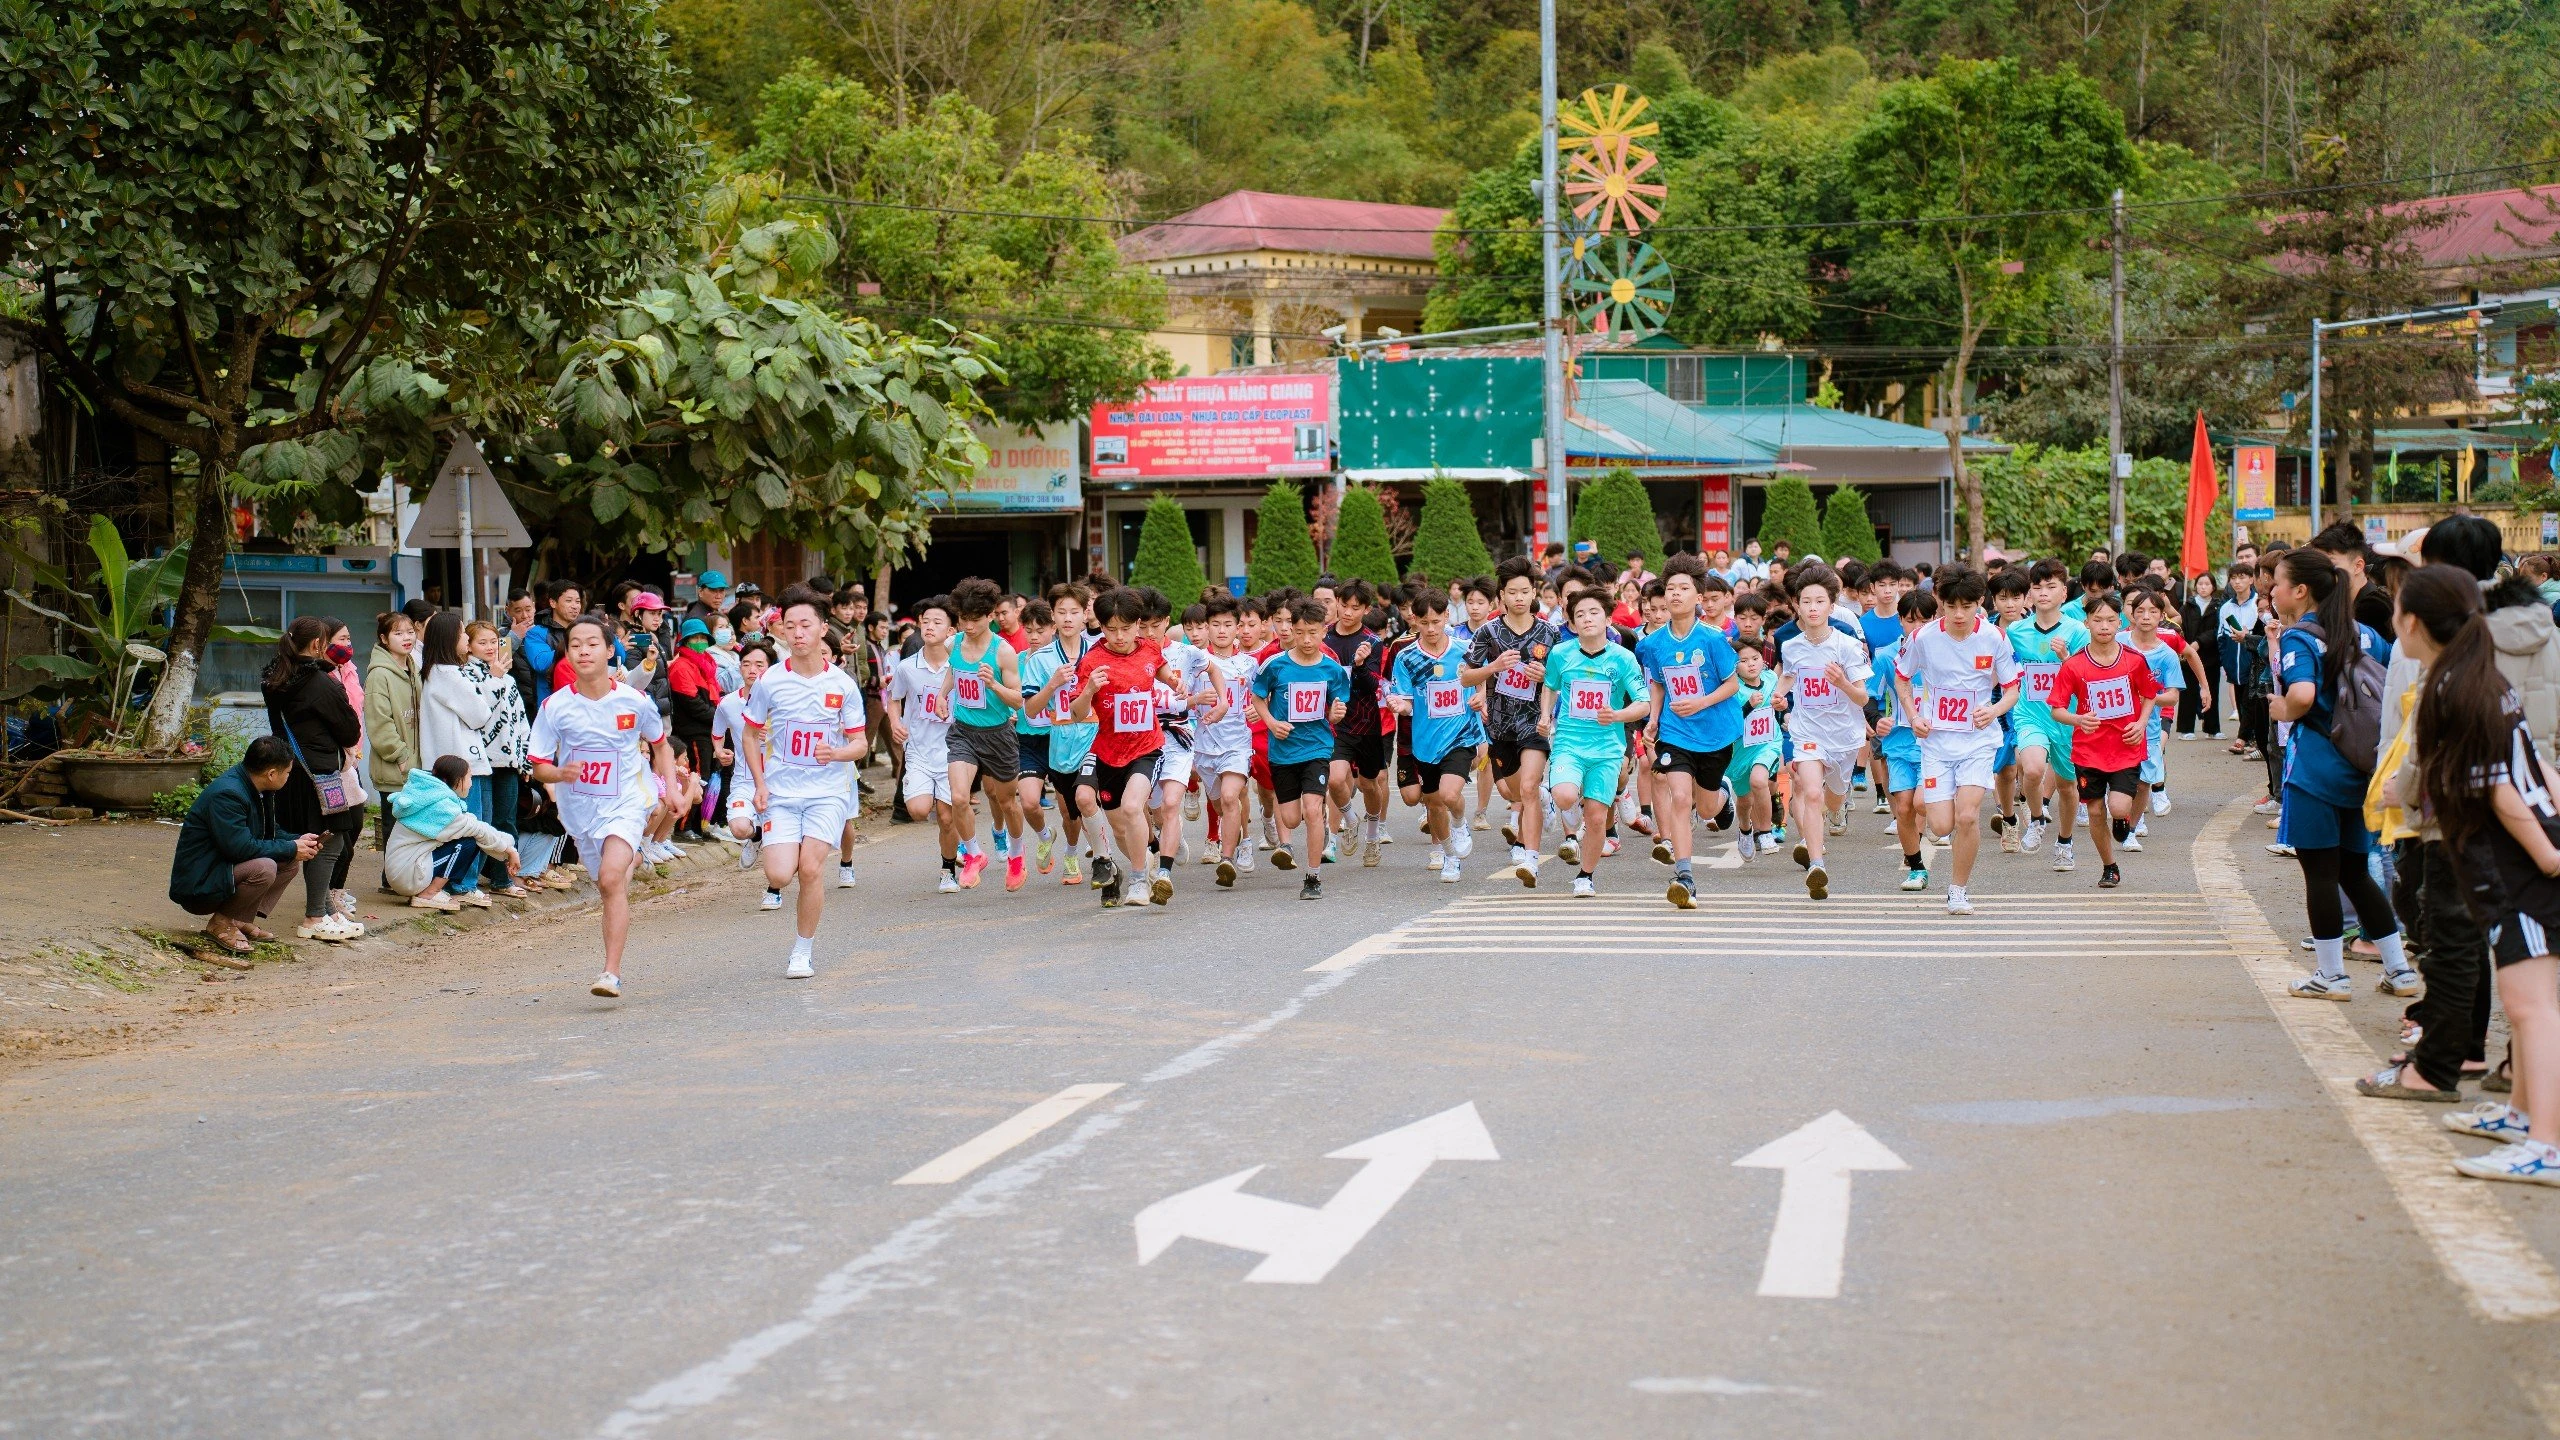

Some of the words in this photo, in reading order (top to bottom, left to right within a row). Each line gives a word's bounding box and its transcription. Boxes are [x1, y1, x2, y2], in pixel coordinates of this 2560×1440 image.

[1270, 383, 1314, 400] GIANG
[1157, 412, 1182, 423] LOAN
[1220, 410, 1239, 422] CAO
[958, 678, 979, 700] 608
[1672, 675, 1698, 696] 349
[1803, 677, 1830, 697] 354
[2033, 673, 2056, 691] 321
[1295, 690, 1321, 713] 627
[1434, 689, 1458, 708] 388
[1577, 690, 1604, 710] 383
[2097, 688, 2124, 709] 315
[1120, 699, 1148, 724] 667
[1938, 697, 1968, 722] 622
[1750, 717, 1770, 736] 331
[791, 731, 823, 757] 617
[579, 762, 612, 785] 327
